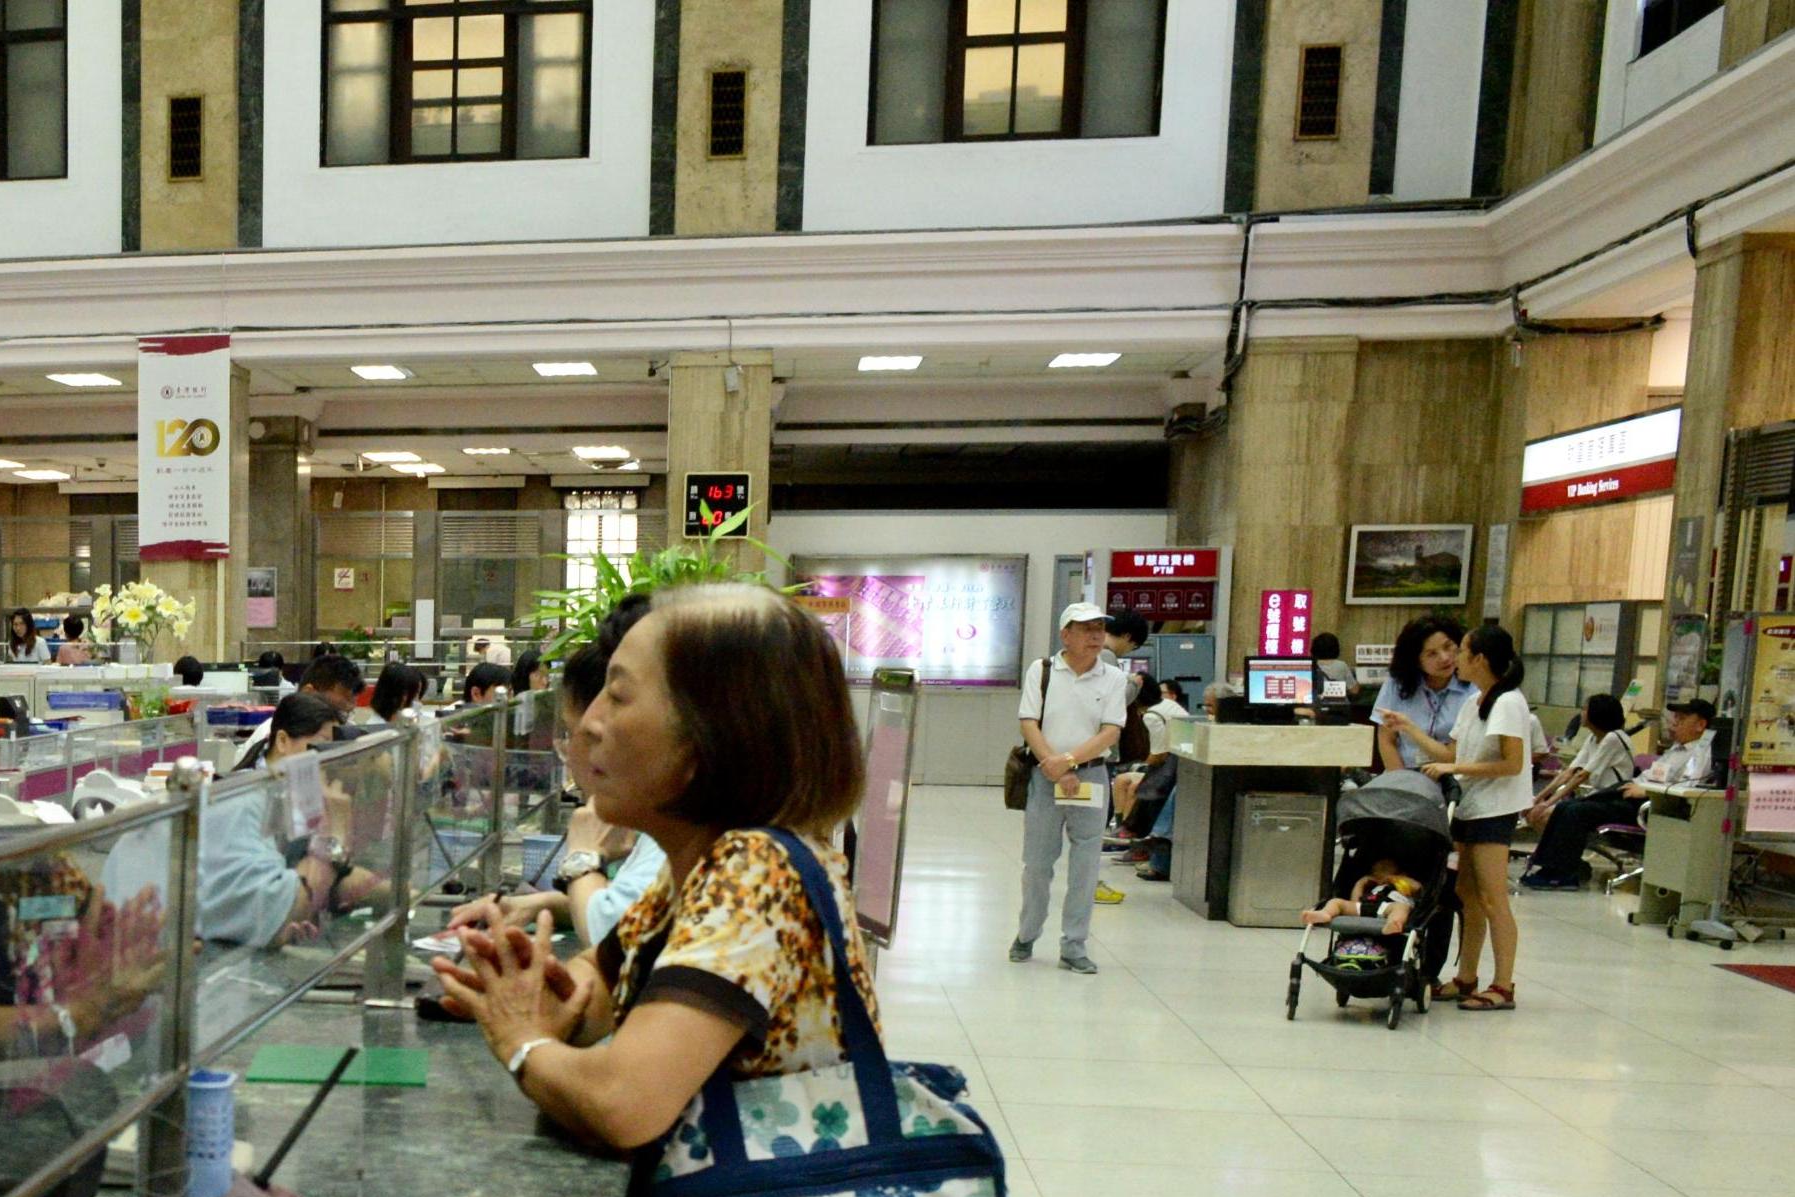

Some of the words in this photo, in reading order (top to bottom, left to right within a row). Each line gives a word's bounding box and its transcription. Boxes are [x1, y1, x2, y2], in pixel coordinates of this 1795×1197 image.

[156, 417, 220, 457] 120
[708, 485, 733, 498] 163
[1153, 566, 1174, 575] PTM
